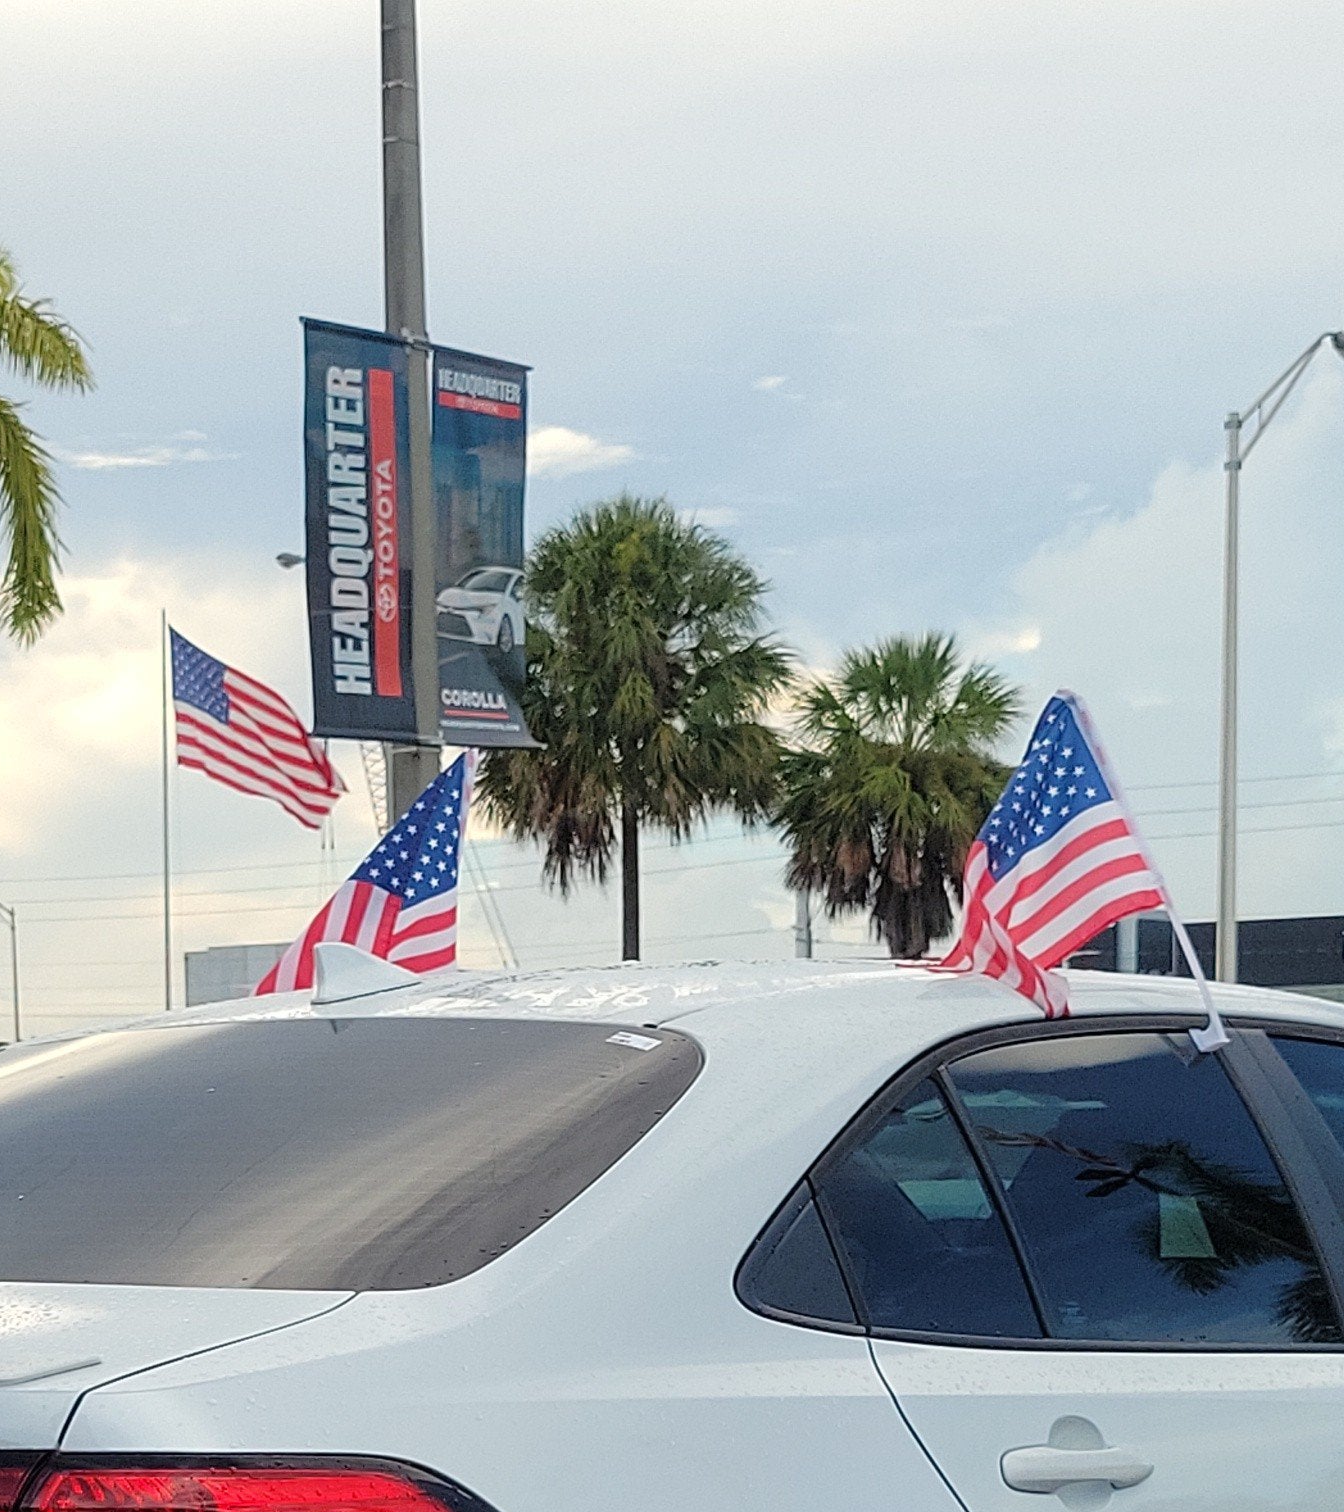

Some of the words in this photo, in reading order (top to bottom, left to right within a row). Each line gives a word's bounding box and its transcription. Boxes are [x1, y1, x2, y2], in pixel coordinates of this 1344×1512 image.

[438, 367, 521, 404] HEADQUARTER
[326, 366, 374, 696] HEADQUARTER
[375, 459, 395, 580] TOYOTA
[441, 688, 507, 710] COROLLA
